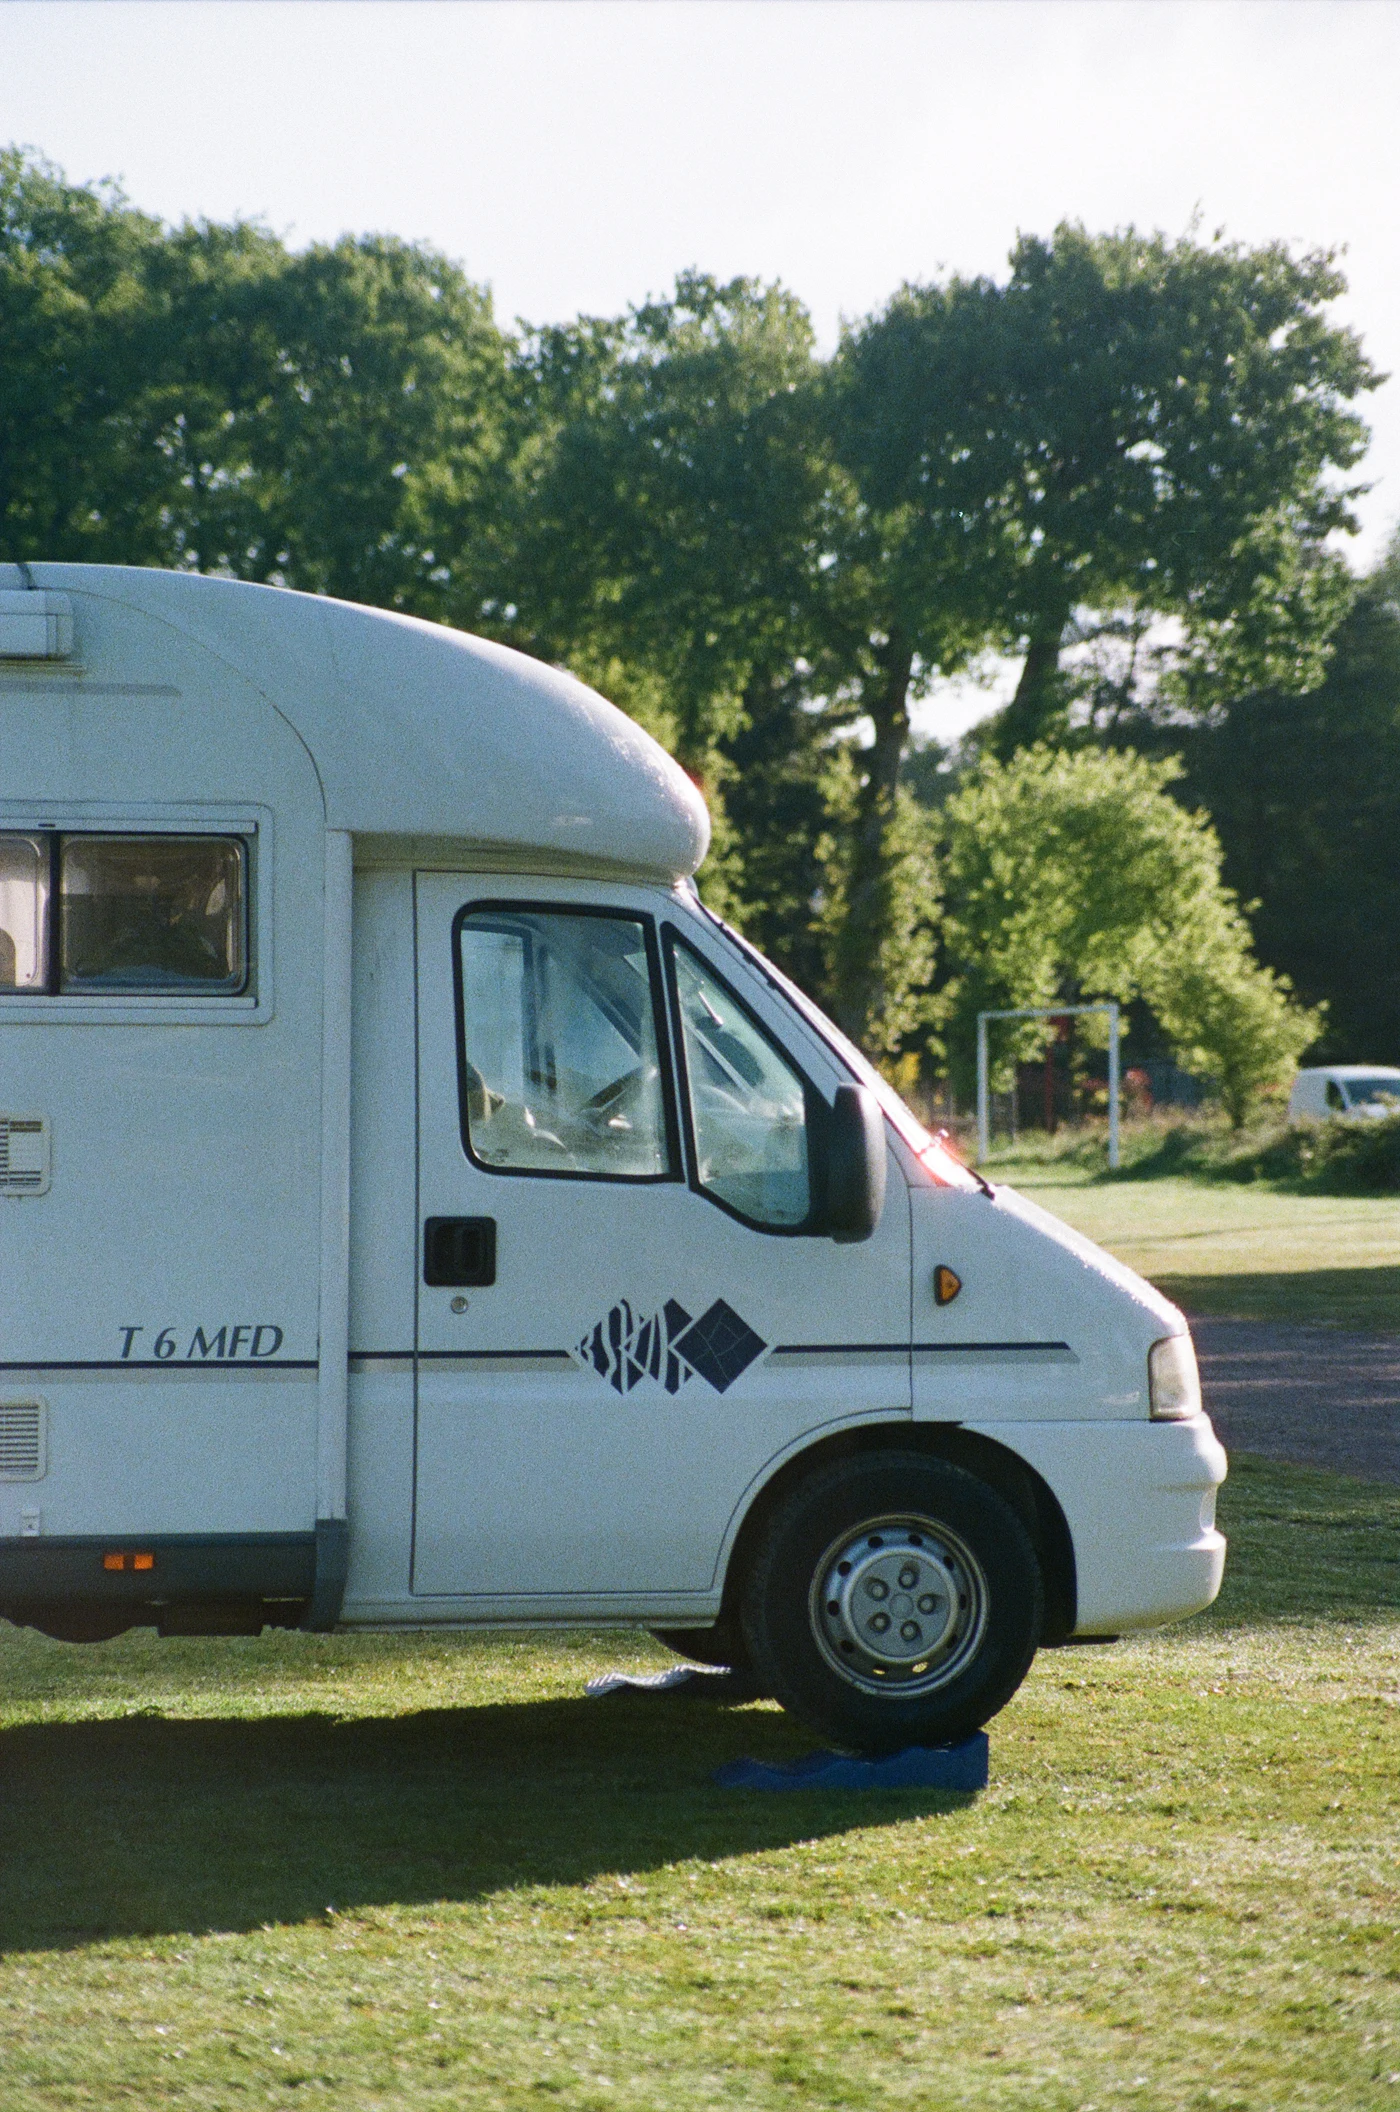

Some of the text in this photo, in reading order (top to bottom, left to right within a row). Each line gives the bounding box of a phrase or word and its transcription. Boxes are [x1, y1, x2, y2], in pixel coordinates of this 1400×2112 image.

[119, 1325, 283, 1359] T 6 MFD
